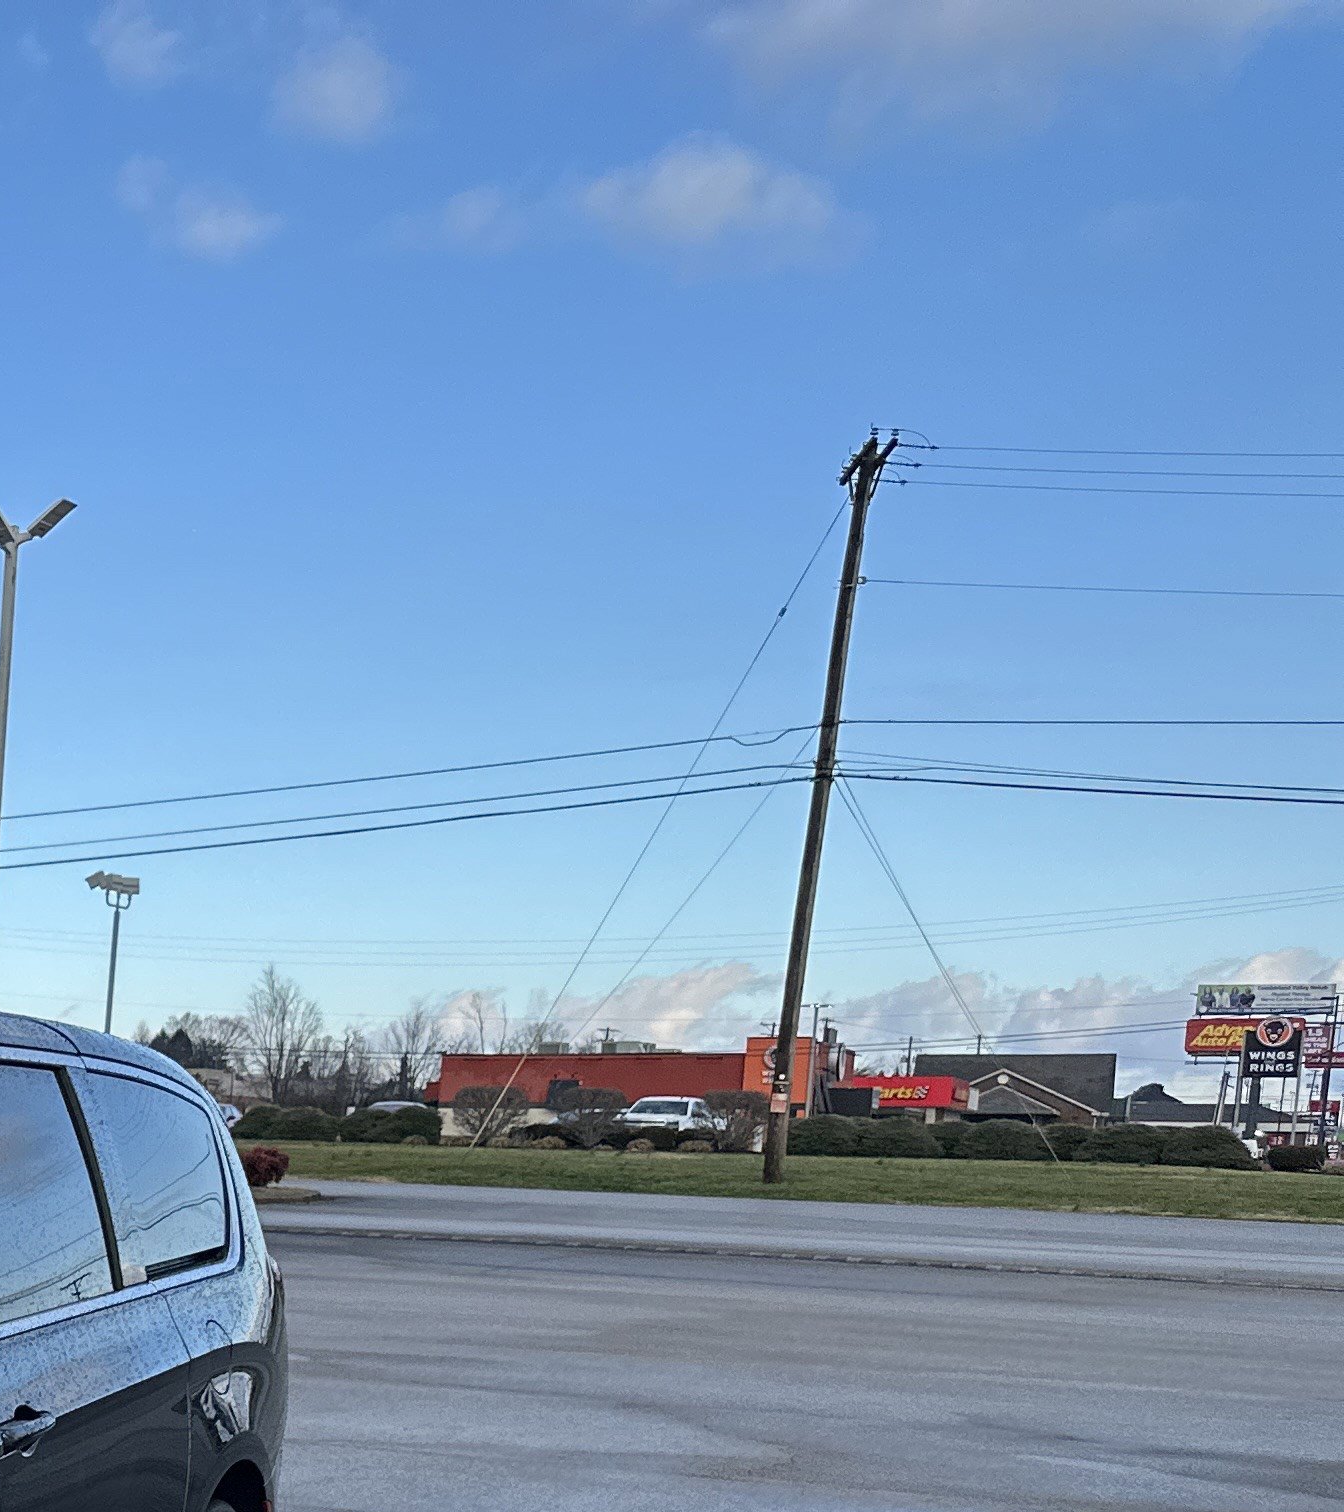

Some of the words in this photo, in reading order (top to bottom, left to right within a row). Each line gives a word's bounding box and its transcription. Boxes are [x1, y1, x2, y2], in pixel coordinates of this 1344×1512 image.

[1248, 1050, 1295, 1061] WINGS
[1249, 1063, 1294, 1073] RINGS
[878, 1086, 914, 1099] arts
